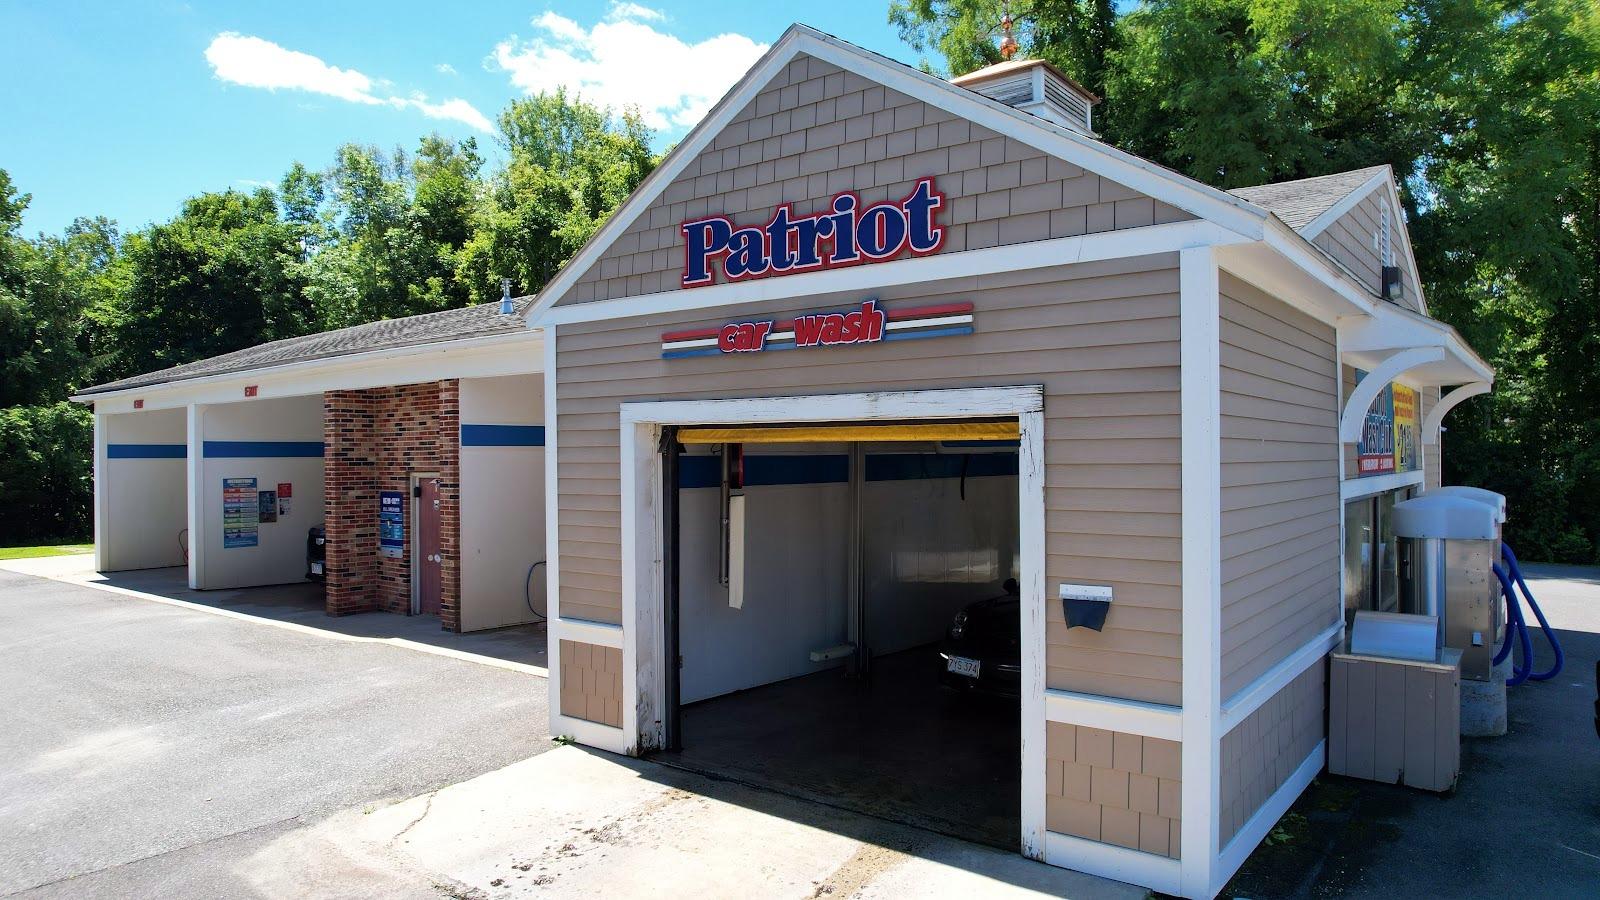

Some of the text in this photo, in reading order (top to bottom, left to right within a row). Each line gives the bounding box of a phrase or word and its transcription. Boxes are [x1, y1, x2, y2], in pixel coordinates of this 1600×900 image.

[681, 177, 944, 287] Patriot
[718, 299, 886, 353] car wash
[245, 386, 258, 397] EXIT
